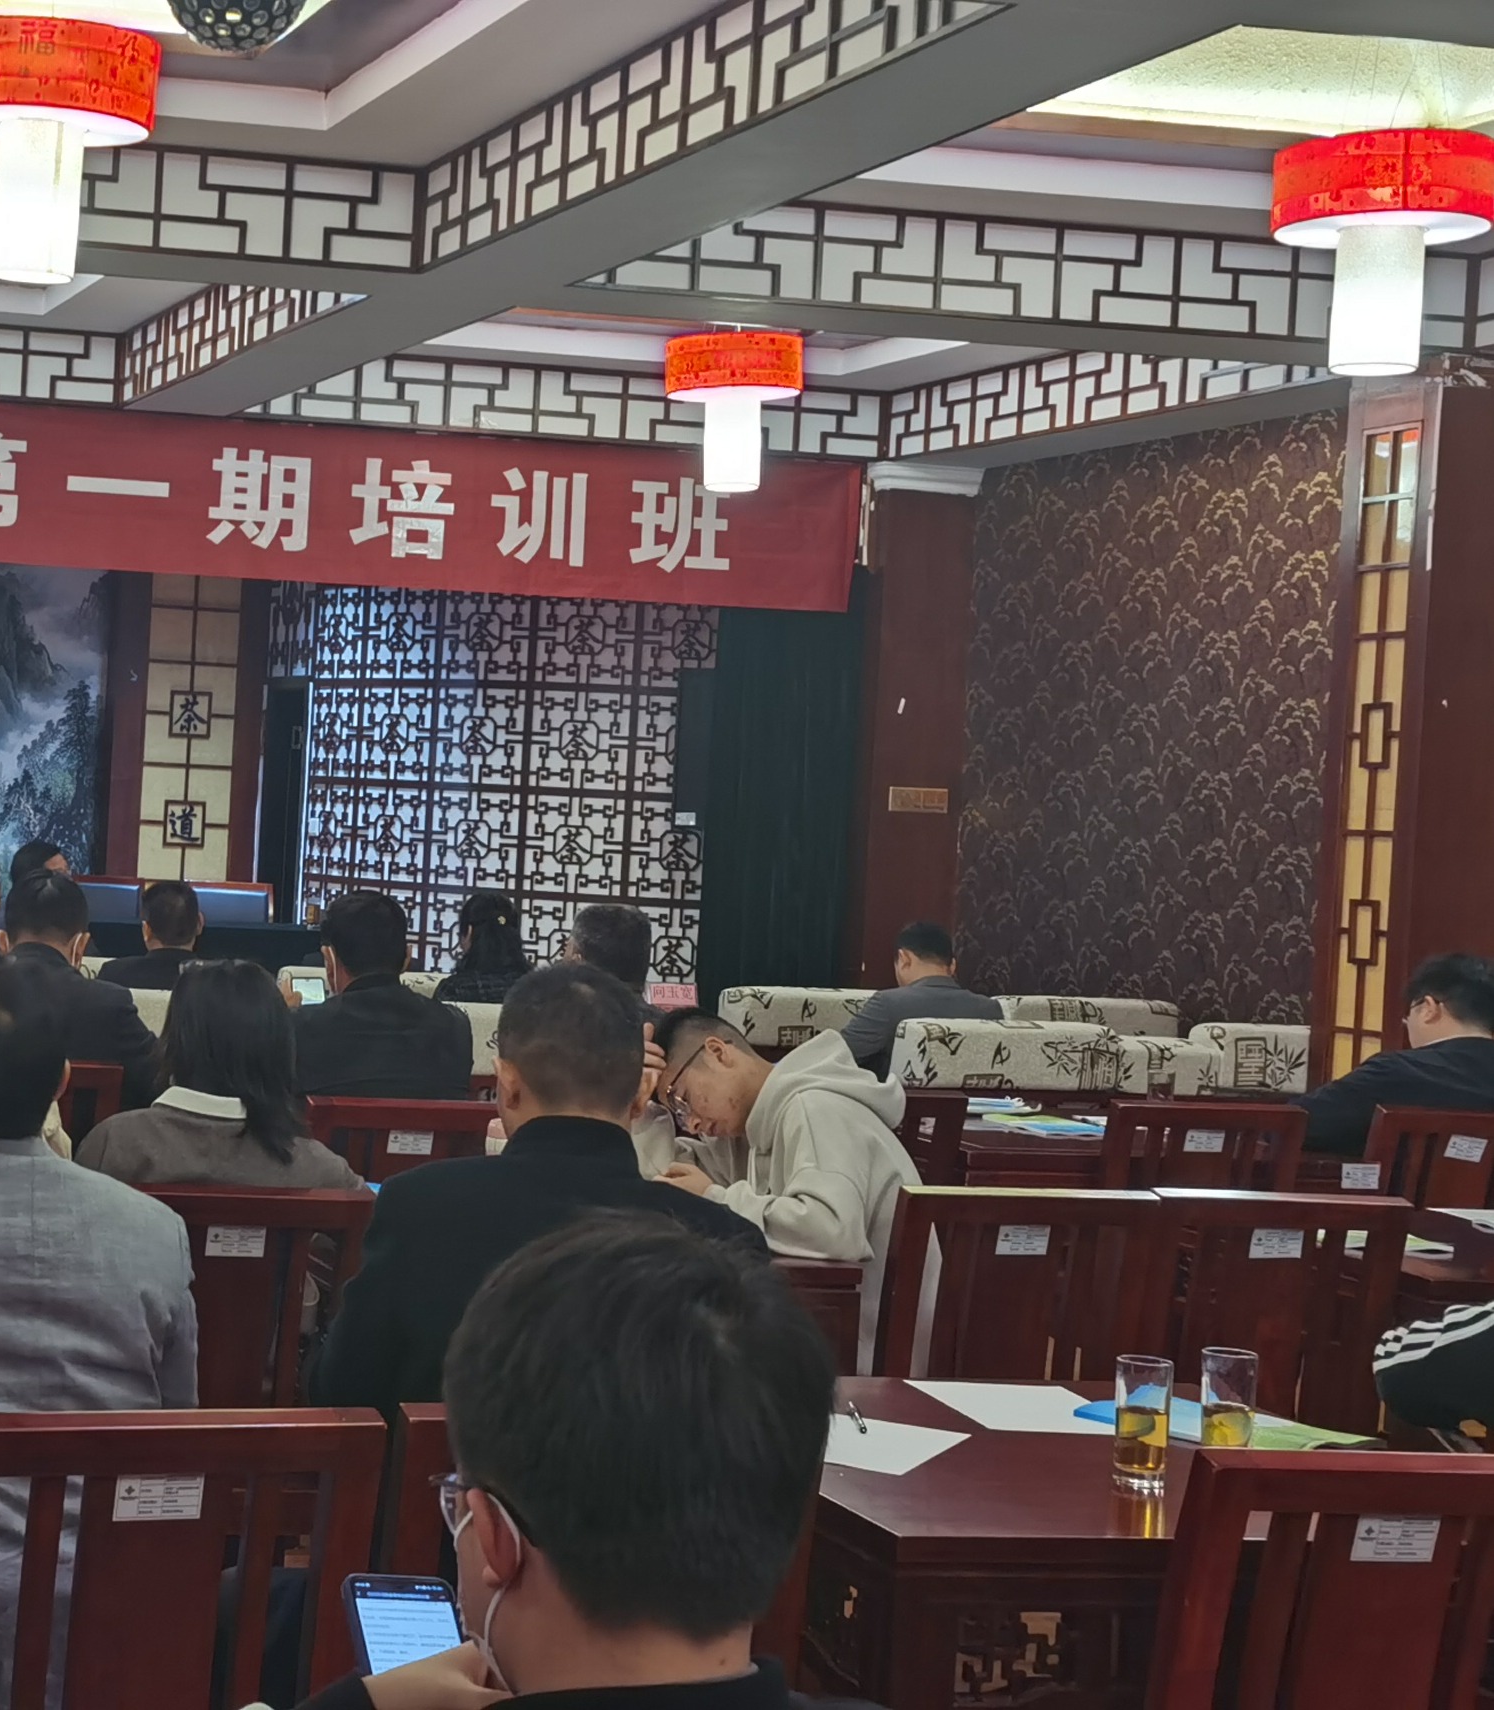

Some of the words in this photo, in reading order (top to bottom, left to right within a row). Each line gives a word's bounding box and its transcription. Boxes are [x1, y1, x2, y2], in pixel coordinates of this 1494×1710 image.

[467, 615, 502, 651] 茶
[568, 618, 604, 655] 茶
[674, 622, 710, 659] 茶
[462, 719, 495, 755] 茶
[561, 724, 597, 760] 茶
[168, 694, 207, 842] 茶道
[457, 822, 490, 858] 茶
[557, 828, 592, 864] 茶
[661, 832, 699, 870] 茶
[654, 939, 693, 977] 茶
